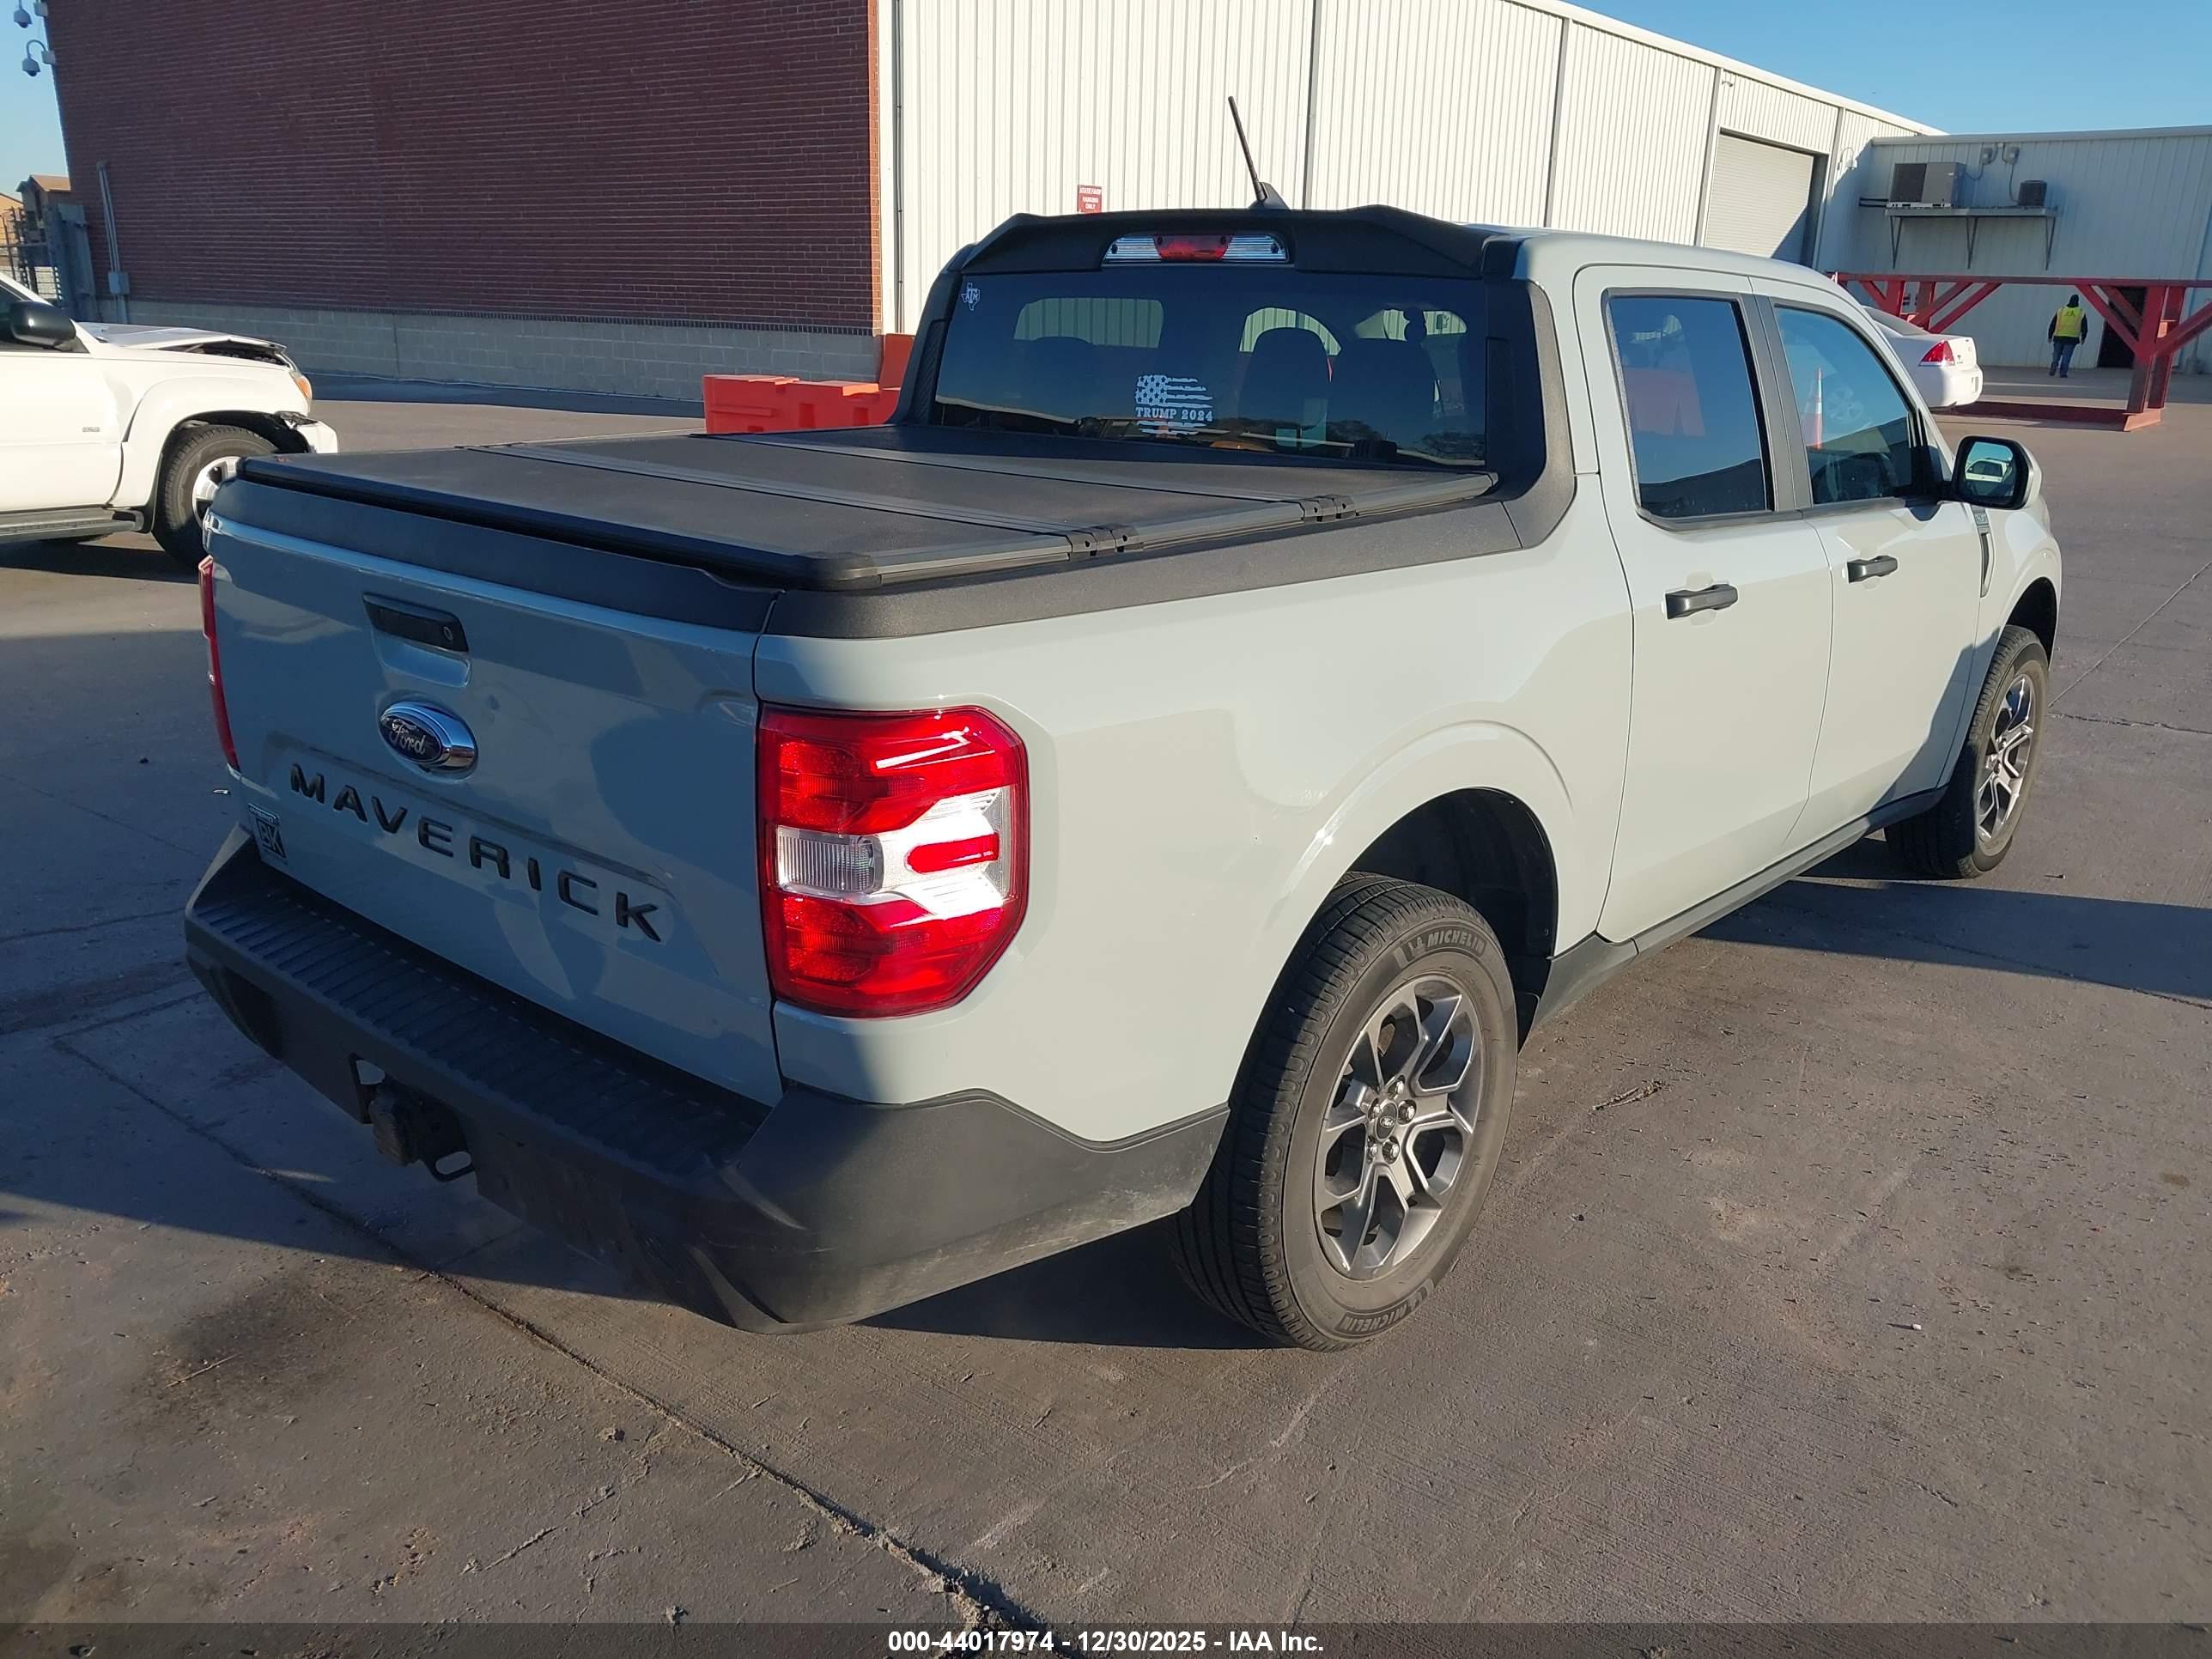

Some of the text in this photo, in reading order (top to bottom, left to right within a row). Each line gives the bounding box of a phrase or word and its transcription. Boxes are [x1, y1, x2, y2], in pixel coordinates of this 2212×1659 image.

[1135, 407, 1213, 422] TRUMP 2024
[389, 720, 427, 755] Ford
[289, 763, 661, 944] MAVERICK
[1427, 929, 1486, 955] MICHELIN
[1340, 1304, 1408, 1333] MICHELIN
